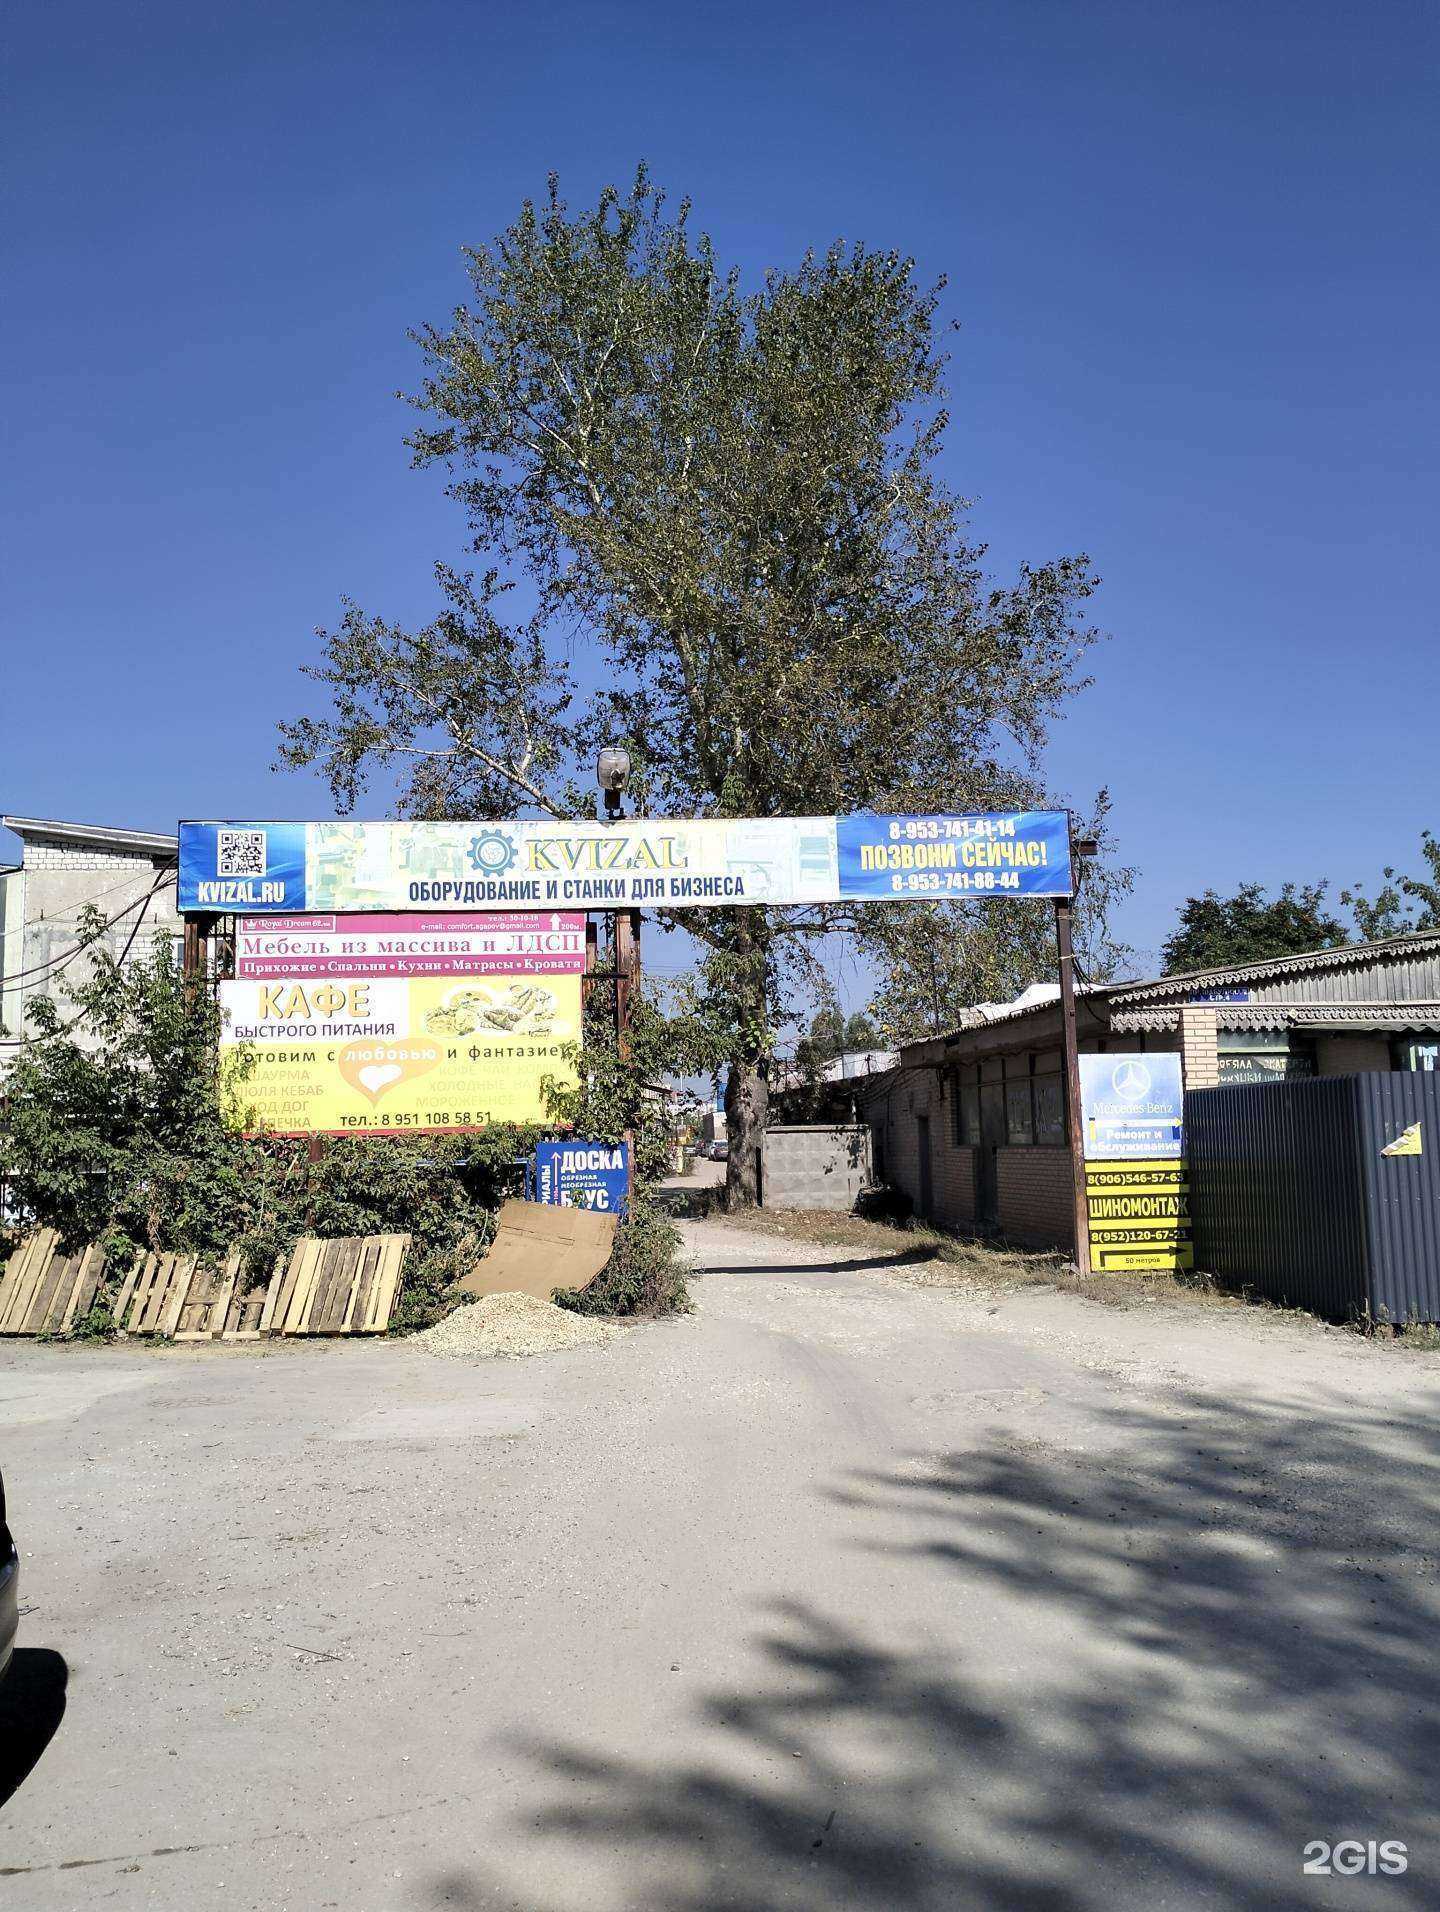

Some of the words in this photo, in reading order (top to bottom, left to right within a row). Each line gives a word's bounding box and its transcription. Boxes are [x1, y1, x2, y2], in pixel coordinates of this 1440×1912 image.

[889, 820, 1015, 840] 8-953-741-41-14
[525, 837, 688, 871] KVIZAL
[860, 842, 956, 871] ПОЗВОНИ
[962, 838, 1048, 867] СЕЙЧАС!
[198, 881, 285, 903] KVIZAL.RU
[409, 880, 541, 903] ОБОРУДОВАНИЕ
[547, 881, 559, 899] И
[563, 879, 626, 899] СТАНКИ
[631, 878, 664, 899] ДЛЯ
[670, 876, 744, 897] БИЗНЕСА
[892, 872, 1019, 891] 8-953-741-88-44
[243, 937, 330, 955] Мебель
[342, 941, 367, 953] из
[377, 941, 471, 953] массива
[482, 941, 496, 951] и
[506, 934, 580, 954] ЛДСП
[243, 962, 317, 975] Прихожие
[327, 961, 387, 972] Спальни
[397, 960, 442, 973] Кухни
[452, 959, 513, 973] Матрасы
[523, 958, 581, 972] Кровати
[258, 984, 371, 1019] КАФЕ
[235, 1024, 317, 1038] БЫСТРОГО
[322, 1023, 395, 1036] ПИТАНИЯ
[327, 1051, 335, 1061] с
[345, 1047, 436, 1062] любовью
[447, 1049, 457, 1059] и
[395, 1113, 418, 1125] 951
[425, 1112, 449, 1124] 108
[455, 1112, 471, 1123] 58
[1105, 1129, 1152, 1140] Ремонт
[560, 1150, 623, 1173] ДОСКА
[1089, 1196, 1188, 1218] ШИНОМОНТАЖ
